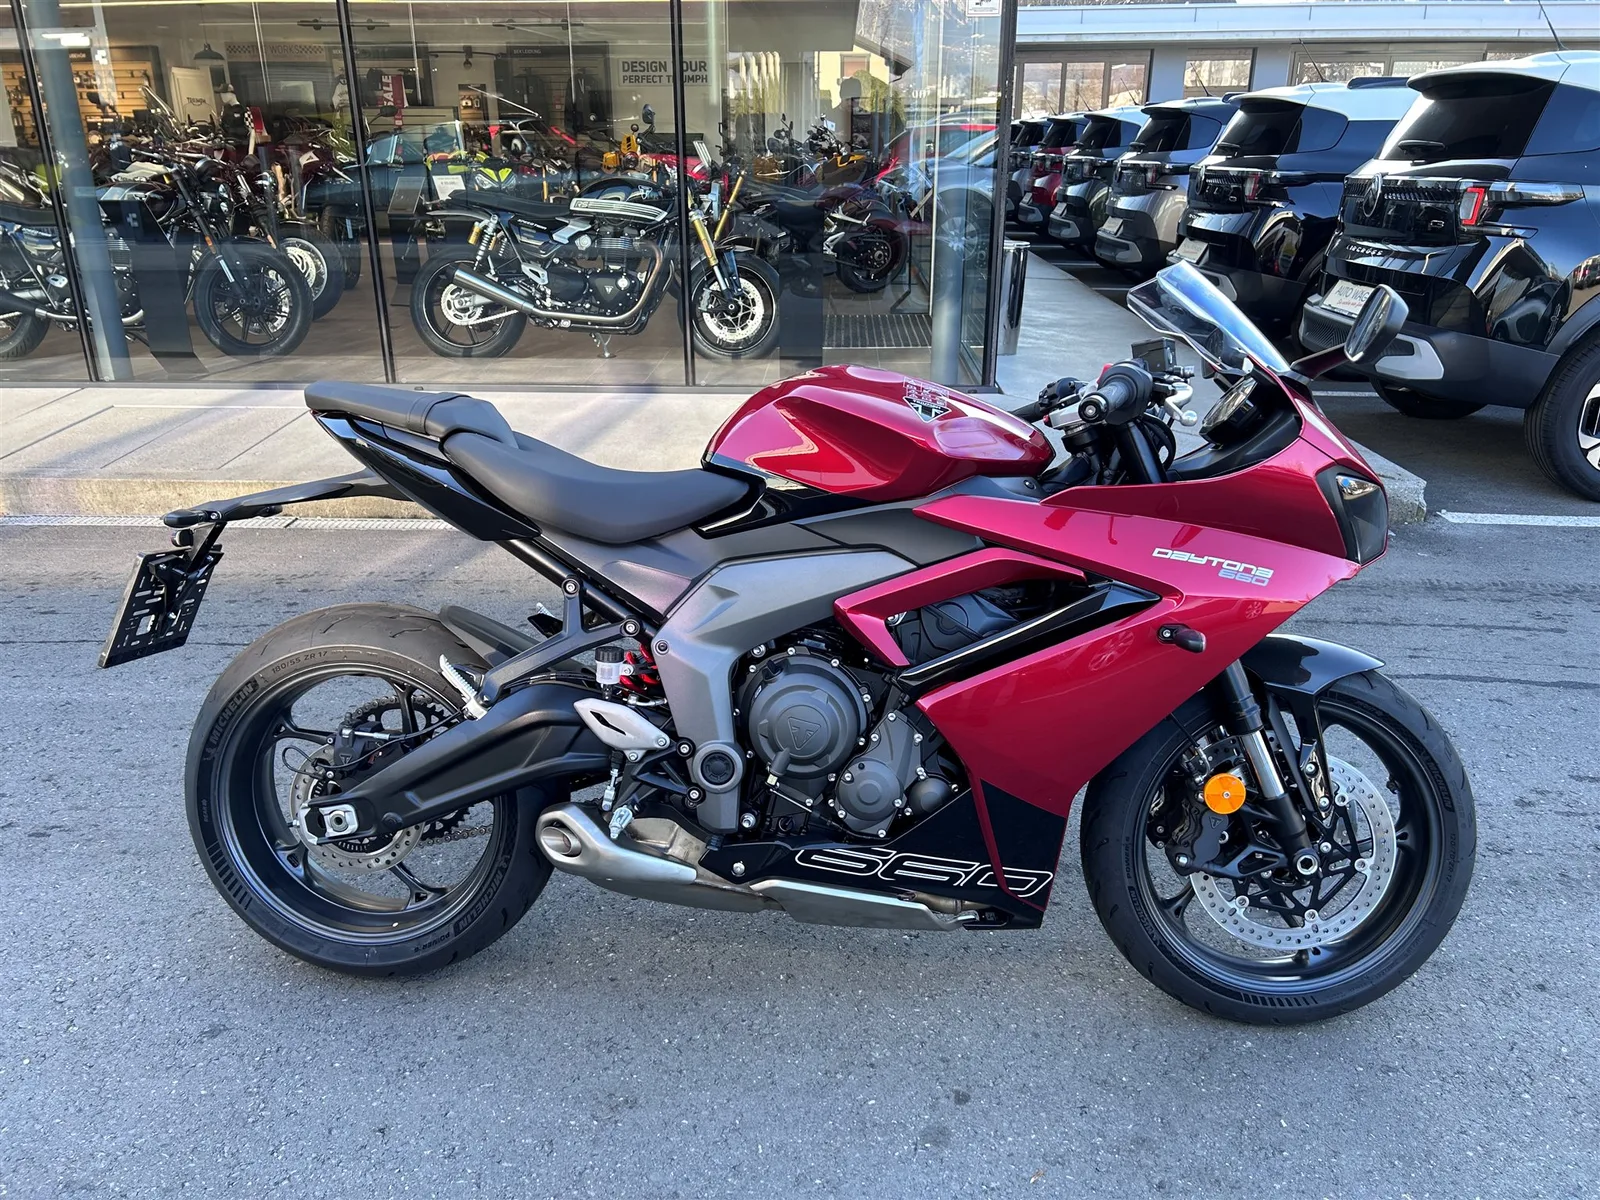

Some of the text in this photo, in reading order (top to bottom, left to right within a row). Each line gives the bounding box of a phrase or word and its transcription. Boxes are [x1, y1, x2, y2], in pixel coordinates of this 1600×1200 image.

[270, 45, 300, 54] WORKS
[622, 61, 707, 72] DESIGN OUR
[623, 75, 708, 83] PERFECT TUMPH
[1335, 286, 1353, 297] AUTO
[1218, 568, 1269, 587] 660
[271, 655, 301, 674] 180/55
[304, 653, 316, 661] ZR
[210, 683, 254, 744] MICHELIN
[1427, 762, 1452, 809] MICHELIN
[795, 847, 1054, 898] 660
[459, 870, 503, 930] MICHELIN
[1130, 889, 1155, 934] MICHELIN
